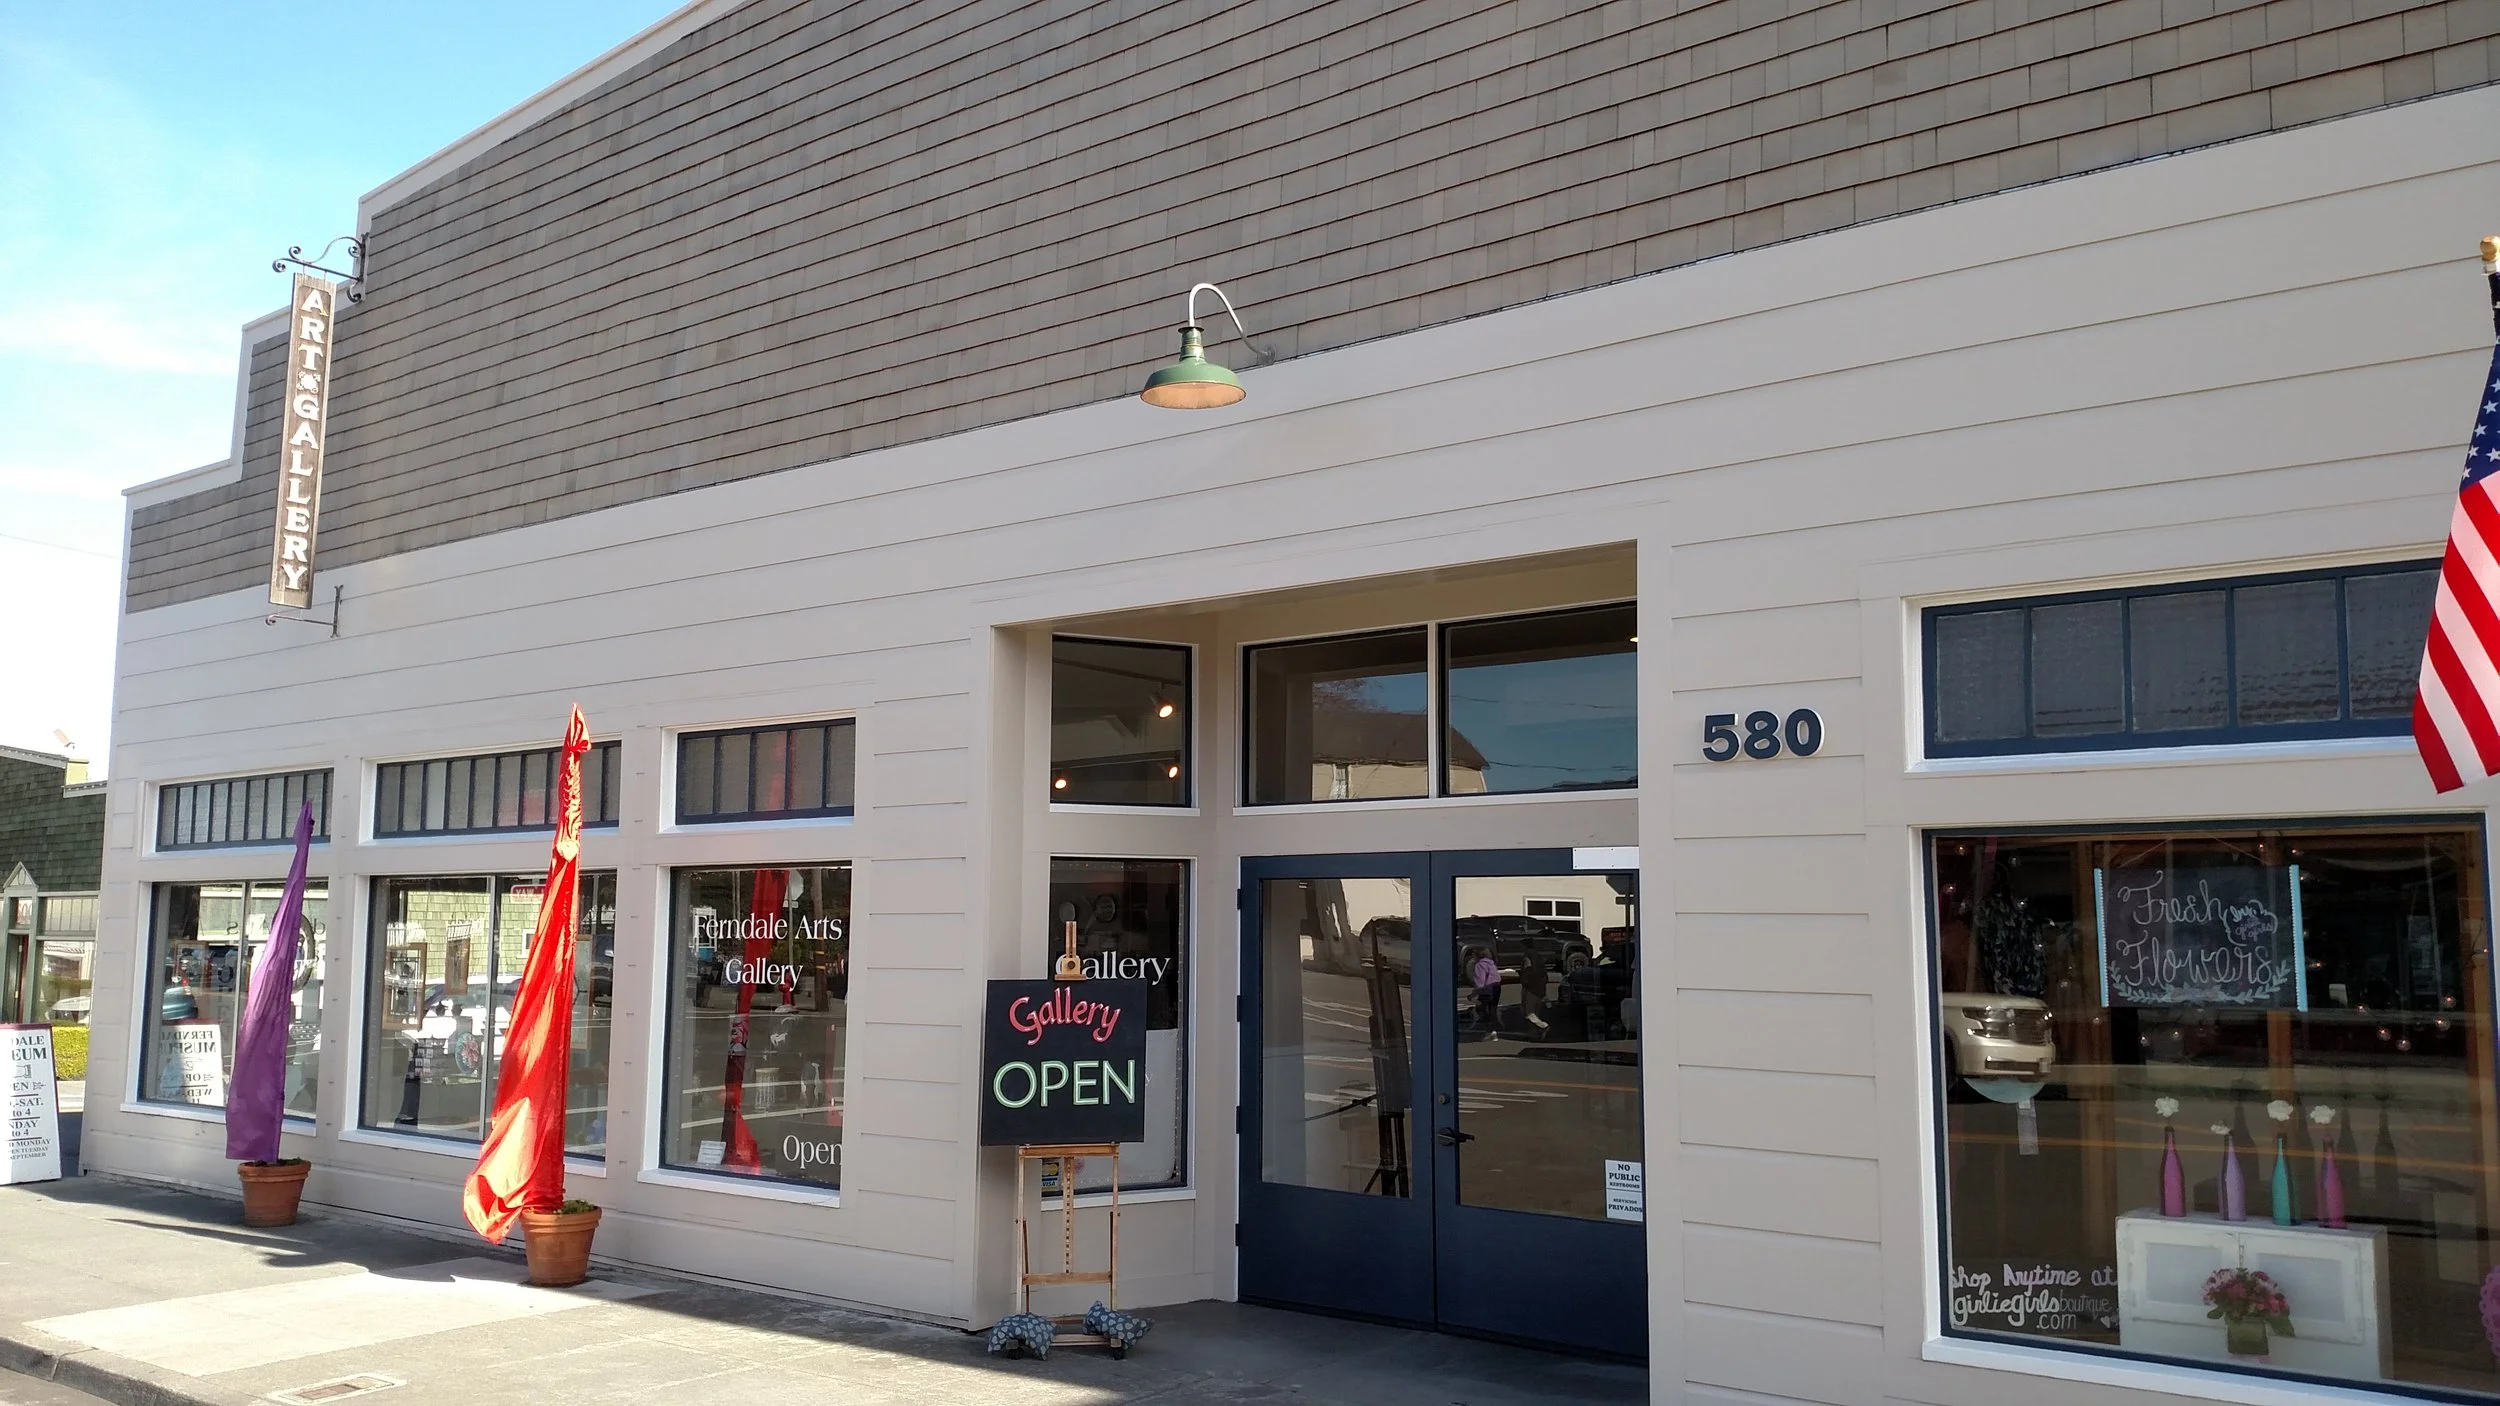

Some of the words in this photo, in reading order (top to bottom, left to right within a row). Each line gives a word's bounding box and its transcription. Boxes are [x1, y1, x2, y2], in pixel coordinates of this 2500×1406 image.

[299, 288, 328, 371] ART
[280, 394, 320, 590] GALLERY
[1702, 707, 1824, 762] 580
[2117, 870, 2226, 925] Fresh
[693, 911, 788, 940] Ferndale
[794, 914, 843, 941] Arts
[725, 957, 804, 992] Gallery
[2116, 929, 2273, 989] Flowers
[1008, 986, 1121, 1046] Gallery
[993, 1060, 1135, 1108] OPEN
[16, 1139, 50, 1147] MONDAY
[783, 1134, 843, 1169] Open
[1609, 1172, 1640, 1182] PUBLIC
[1617, 1163, 1631, 1171] NO
[1609, 1181, 1640, 1189] RESTROOMS
[1608, 1203, 1643, 1213] PRIVADOS
[2091, 1265, 2117, 1286] at
